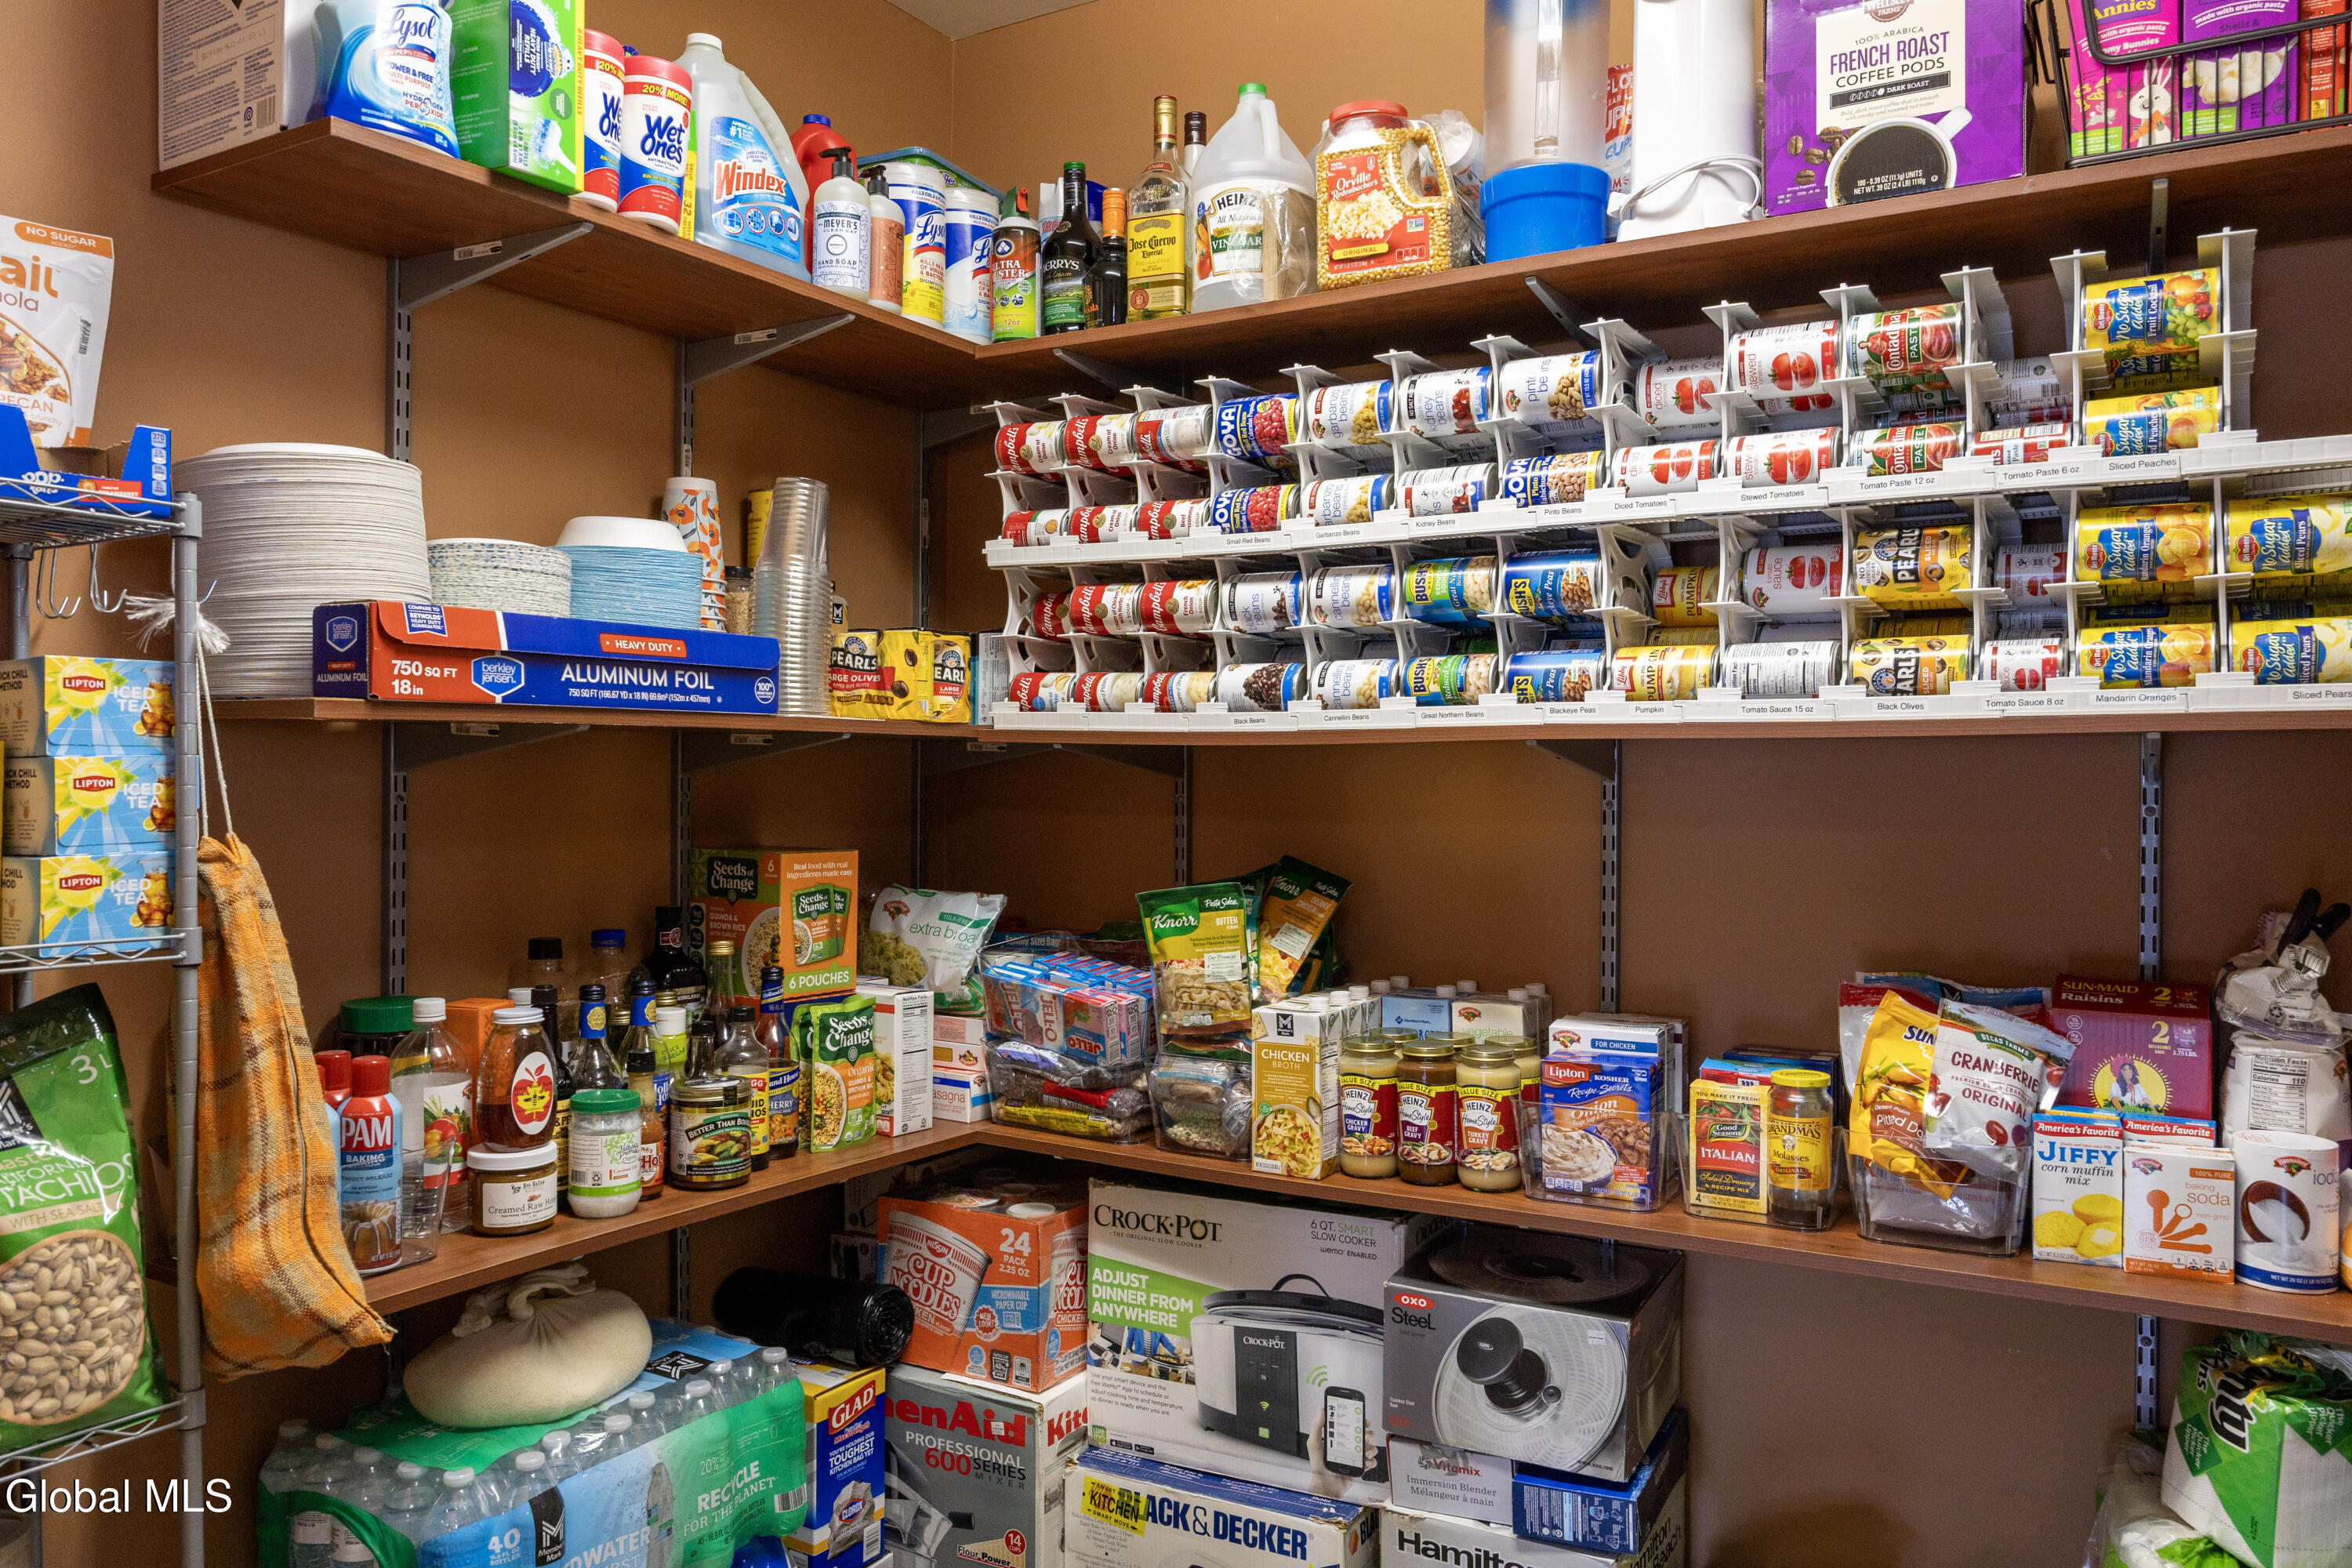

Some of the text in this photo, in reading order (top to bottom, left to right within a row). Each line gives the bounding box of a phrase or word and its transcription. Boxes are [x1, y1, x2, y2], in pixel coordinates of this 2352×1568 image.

[383, 9, 436, 48] Lysol
[1883, 26, 1924, 38] ARABICA
[1830, 31, 1950, 75] FRENCH ROAST
[1836, 56, 1945, 88] COFFEE PODS
[1887, 80, 1929, 93] DARK ROAST
[642, 84, 688, 106] 20% MORE!
[644, 114, 684, 143] Wet
[641, 132, 683, 164] Ones
[714, 160, 787, 201] Windex
[1336, 172, 1371, 191] Orville
[823, 220, 858, 230] MEYER'S
[26, 227, 96, 248] NO SUGAR
[1129, 236, 1176, 252] Jose Cuervo
[1343, 245, 1377, 257] ORIGINAL
[2109, 459, 2177, 470] Sliced Peaches
[2003, 471, 2033, 481] Tomato
[2035, 469, 2060, 478] Paste
[1860, 481, 1886, 490] Tomato
[1769, 490, 1804, 499] Tomatoes
[1634, 499, 1668, 508] Tomatoes
[1416, 519, 1436, 528] Kidney
[615, 640, 673, 652] HEAVY DUTY
[831, 651, 877, 671] PEARLS
[391, 660, 457, 678] 750 SQ FT
[482, 662, 516, 676] berkley
[64, 679, 104, 688] LIPTON
[561, 663, 714, 690] ALUMINUM FOIL
[114, 686, 155, 700] ICED
[391, 680, 423, 695] 18 in
[1986, 699, 2016, 707] Tomato
[2018, 698, 2044, 706] Sauce
[2096, 693, 2177, 703] Mandarin Oranges
[116, 699, 152, 713] TEA
[1635, 706, 1664, 715] Pumpkin
[1741, 706, 1767, 714] Tomato
[1877, 702, 1924, 711] Black Olives
[74, 779, 114, 789] LIPTON
[123, 782, 164, 797] ICED
[126, 796, 161, 809] TEA
[713, 861, 746, 876] Seeds
[61, 877, 100, 887] LIPTON
[110, 879, 151, 892] ICED
[711, 875, 754, 891] Change
[113, 891, 148, 906] TEA
[1152, 914, 1198, 929] Knorr
[1216, 916, 1238, 926] BUTTER
[789, 971, 849, 989] 6 POUCHES
[1610, 1041, 1636, 1050] CHICKEN
[1261, 1049, 1310, 1063] CHICKEN
[1272, 1061, 1300, 1070] BROTH
[1549, 1065, 1585, 1080] Lipton
[1345, 1089, 1369, 1099] HEINZ
[1402, 1096, 1425, 1107] HEINZ
[1466, 1102, 1491, 1112] HEINZ
[1345, 1118, 1368, 1127] CHICKEN
[1347, 1123, 1365, 1132] GRAVY
[341, 1116, 391, 1148] PAM
[1404, 1130, 1421, 1138] GRAVY
[2038, 1123, 2119, 1138] America's Favorite
[1701, 1147, 1755, 1163] ITALIAN
[2042, 1163, 2114, 1177] corn muffin
[2065, 1175, 2090, 1186] mix
[2185, 1181, 2215, 1192] baking
[2187, 1191, 2230, 1206] soda
[1000, 1228, 1031, 1256] 24
[1311, 1231, 1376, 1247] SLOW COOKER
[1004, 1254, 1026, 1266] PACK
[1092, 1268, 1149, 1289] ADJUST
[1092, 1284, 1193, 1313] DINNER FROM
[1091, 1302, 1178, 1328] ANYWHERE
[832, 1385, 873, 1429] GLAD
[906, 1431, 1024, 1468] PROFESSIONAL
[925, 1448, 1026, 1480] 600 SERIES
[1434, 1458, 1481, 1476] Vitamix
[697, 1461, 760, 1513] RECYCLE
[842, 1501, 863, 1520] CLOROX
[1089, 1494, 1139, 1523] KITCHEN
[1213, 1511, 1307, 1561] DECKER
